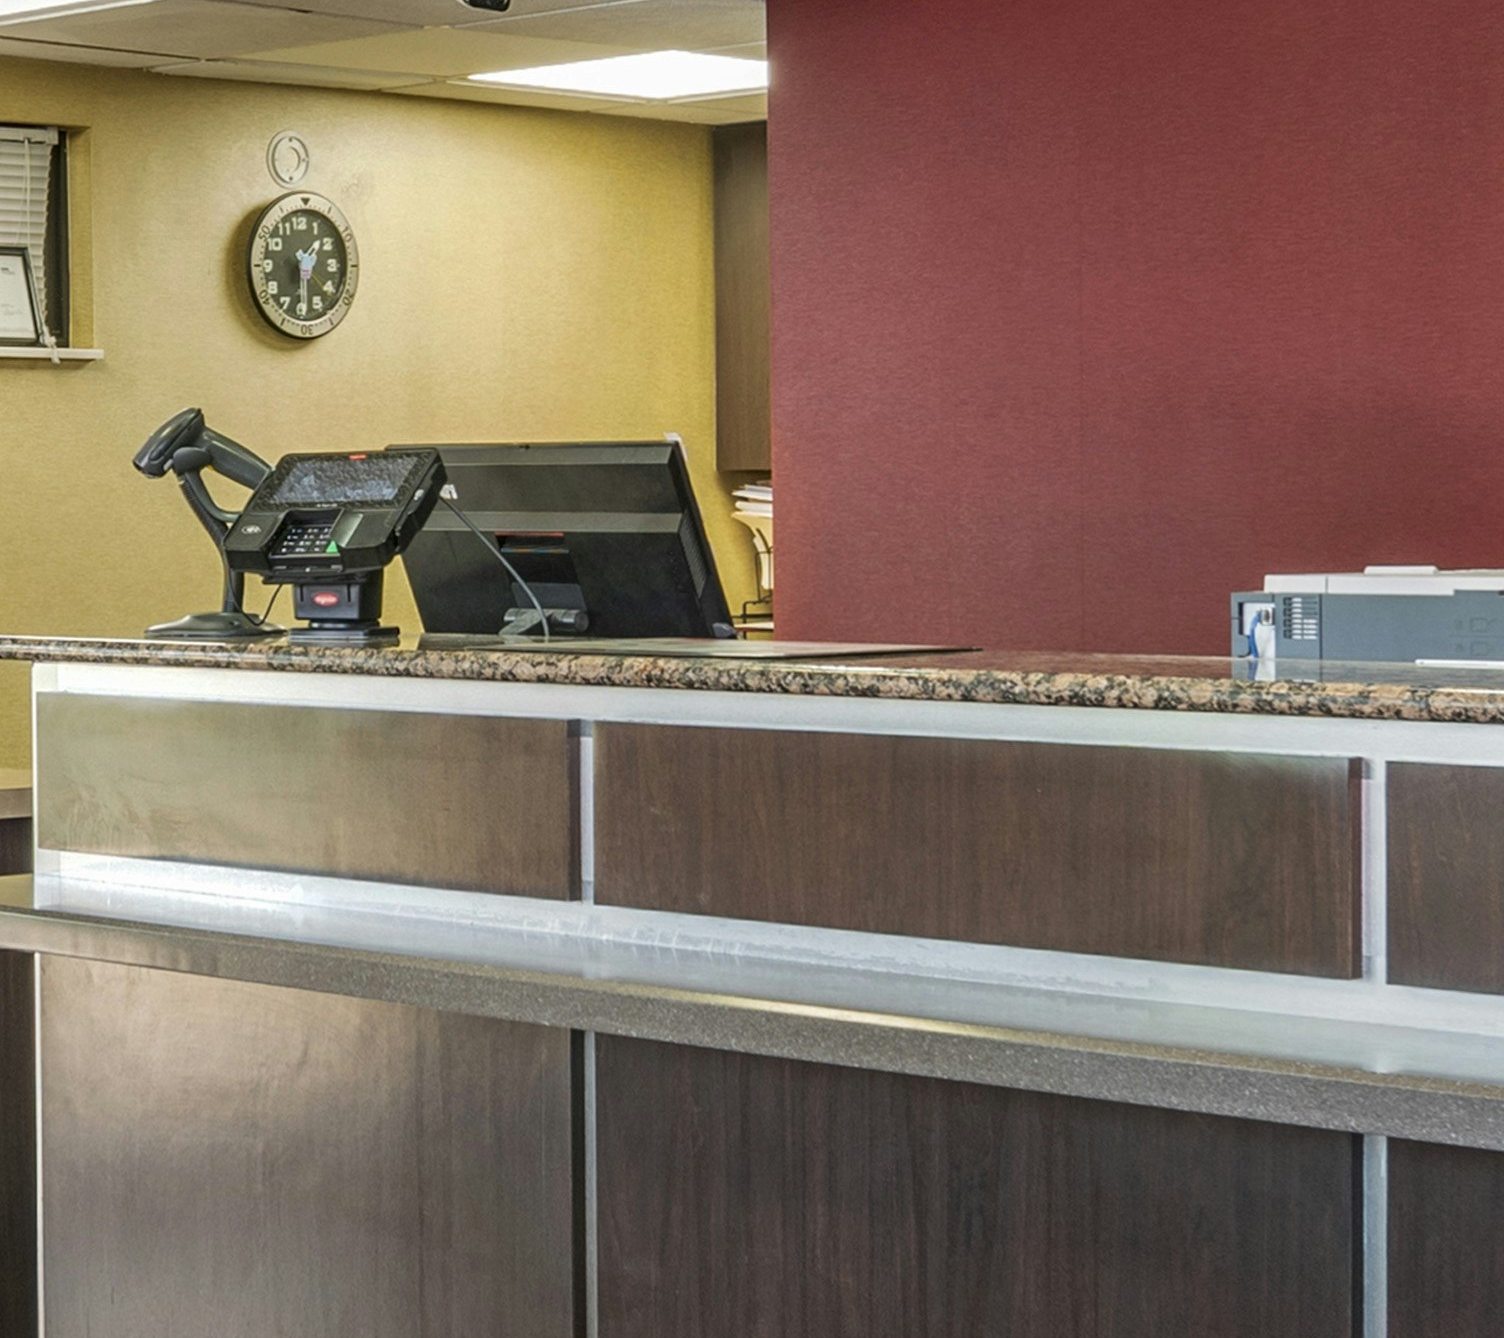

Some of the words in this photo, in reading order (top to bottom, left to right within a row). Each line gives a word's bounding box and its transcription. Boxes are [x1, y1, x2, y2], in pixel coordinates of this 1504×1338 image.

[277, 222, 291, 236] 11
[292, 217, 307, 230] 12
[312, 222, 318, 235] 1
[258, 225, 270, 241] 50
[341, 226, 352, 242] 10
[267, 238, 283, 251] 10
[323, 237, 333, 251] 2
[263, 259, 273, 272] 9
[327, 259, 337, 272] 3
[267, 281, 278, 294] 8
[323, 280, 335, 293] 4
[259, 290, 270, 306] 40
[280, 296, 291, 310] 7
[312, 296, 323, 309] 5
[342, 289, 353, 306] 20
[300, 325, 314, 335] 30
